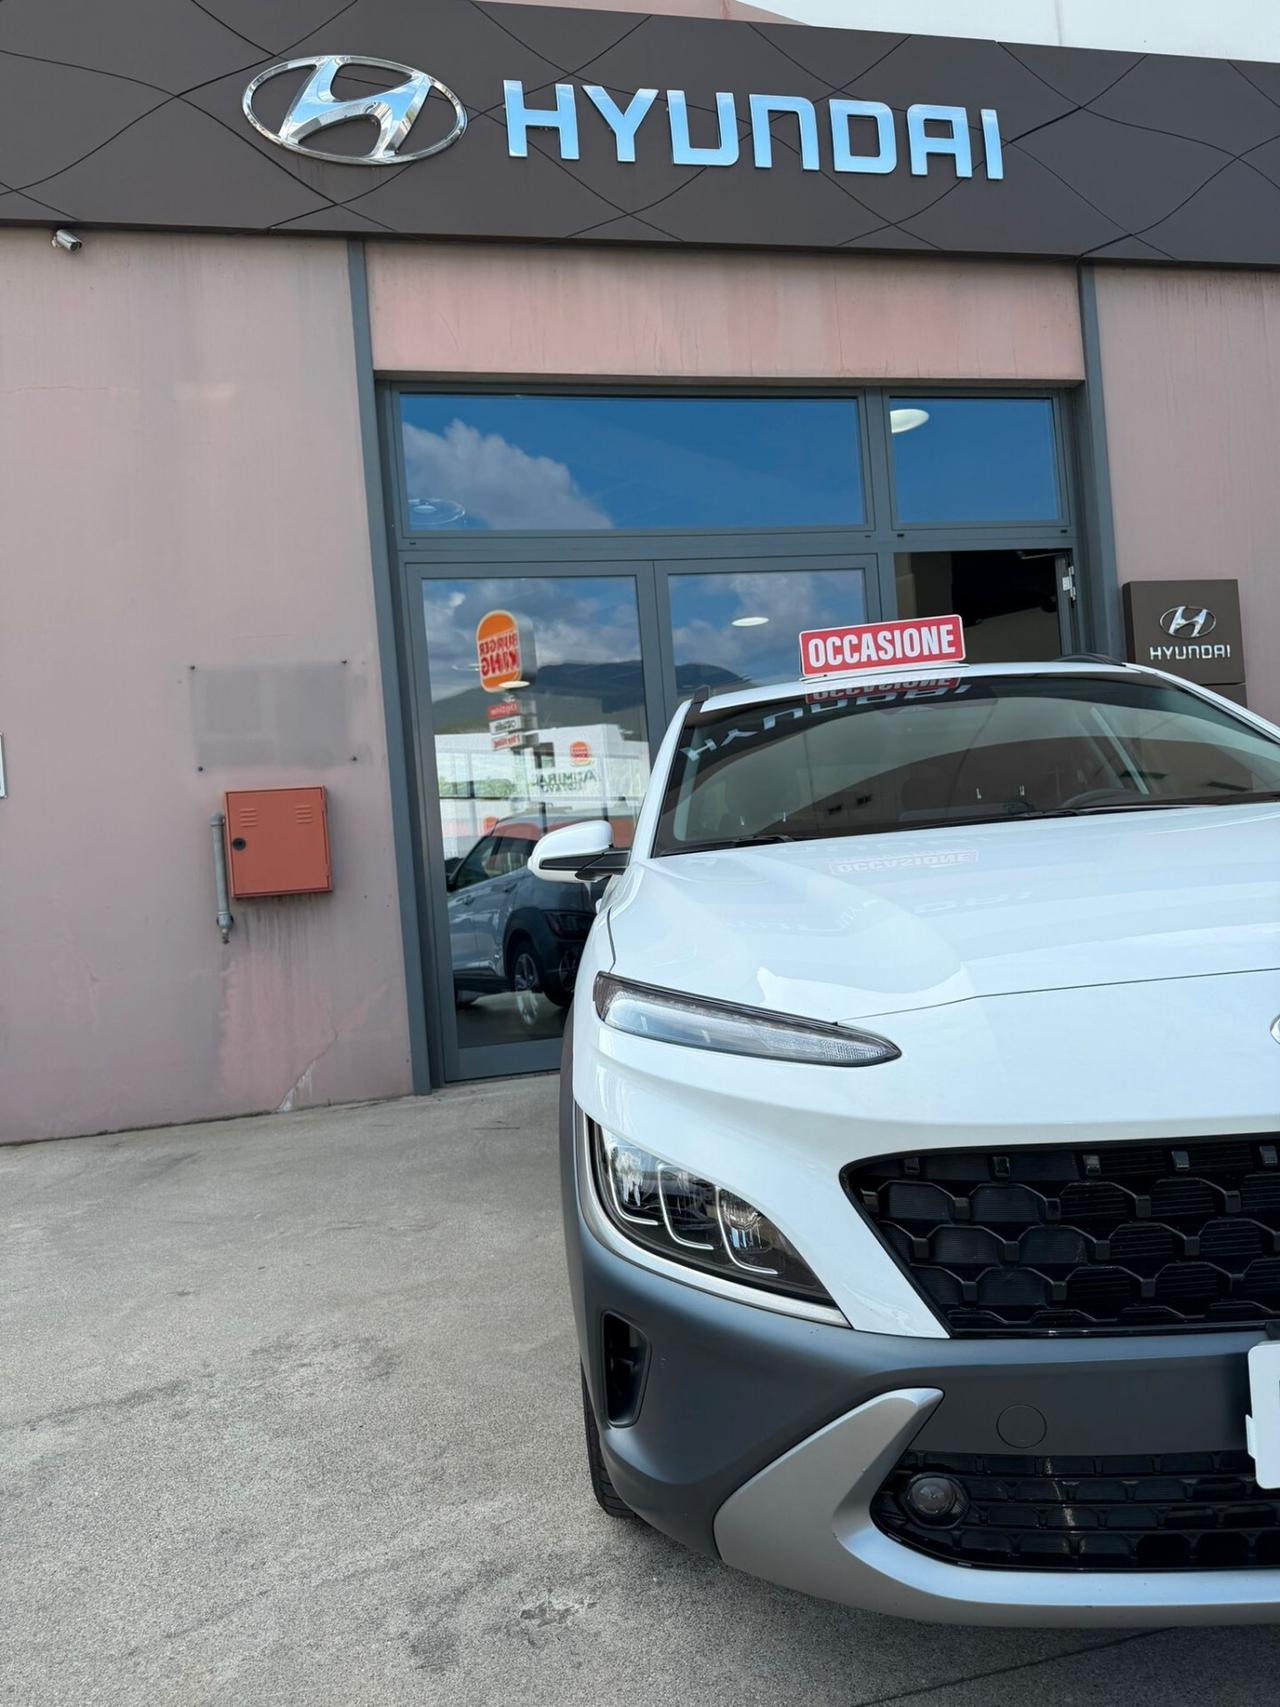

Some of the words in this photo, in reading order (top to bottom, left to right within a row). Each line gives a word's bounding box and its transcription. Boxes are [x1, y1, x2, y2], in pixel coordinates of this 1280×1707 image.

[503, 79, 1004, 180] HYUNDAI
[807, 622, 957, 668] OCCASIONE
[1149, 644, 1231, 661] HYUNDAI
